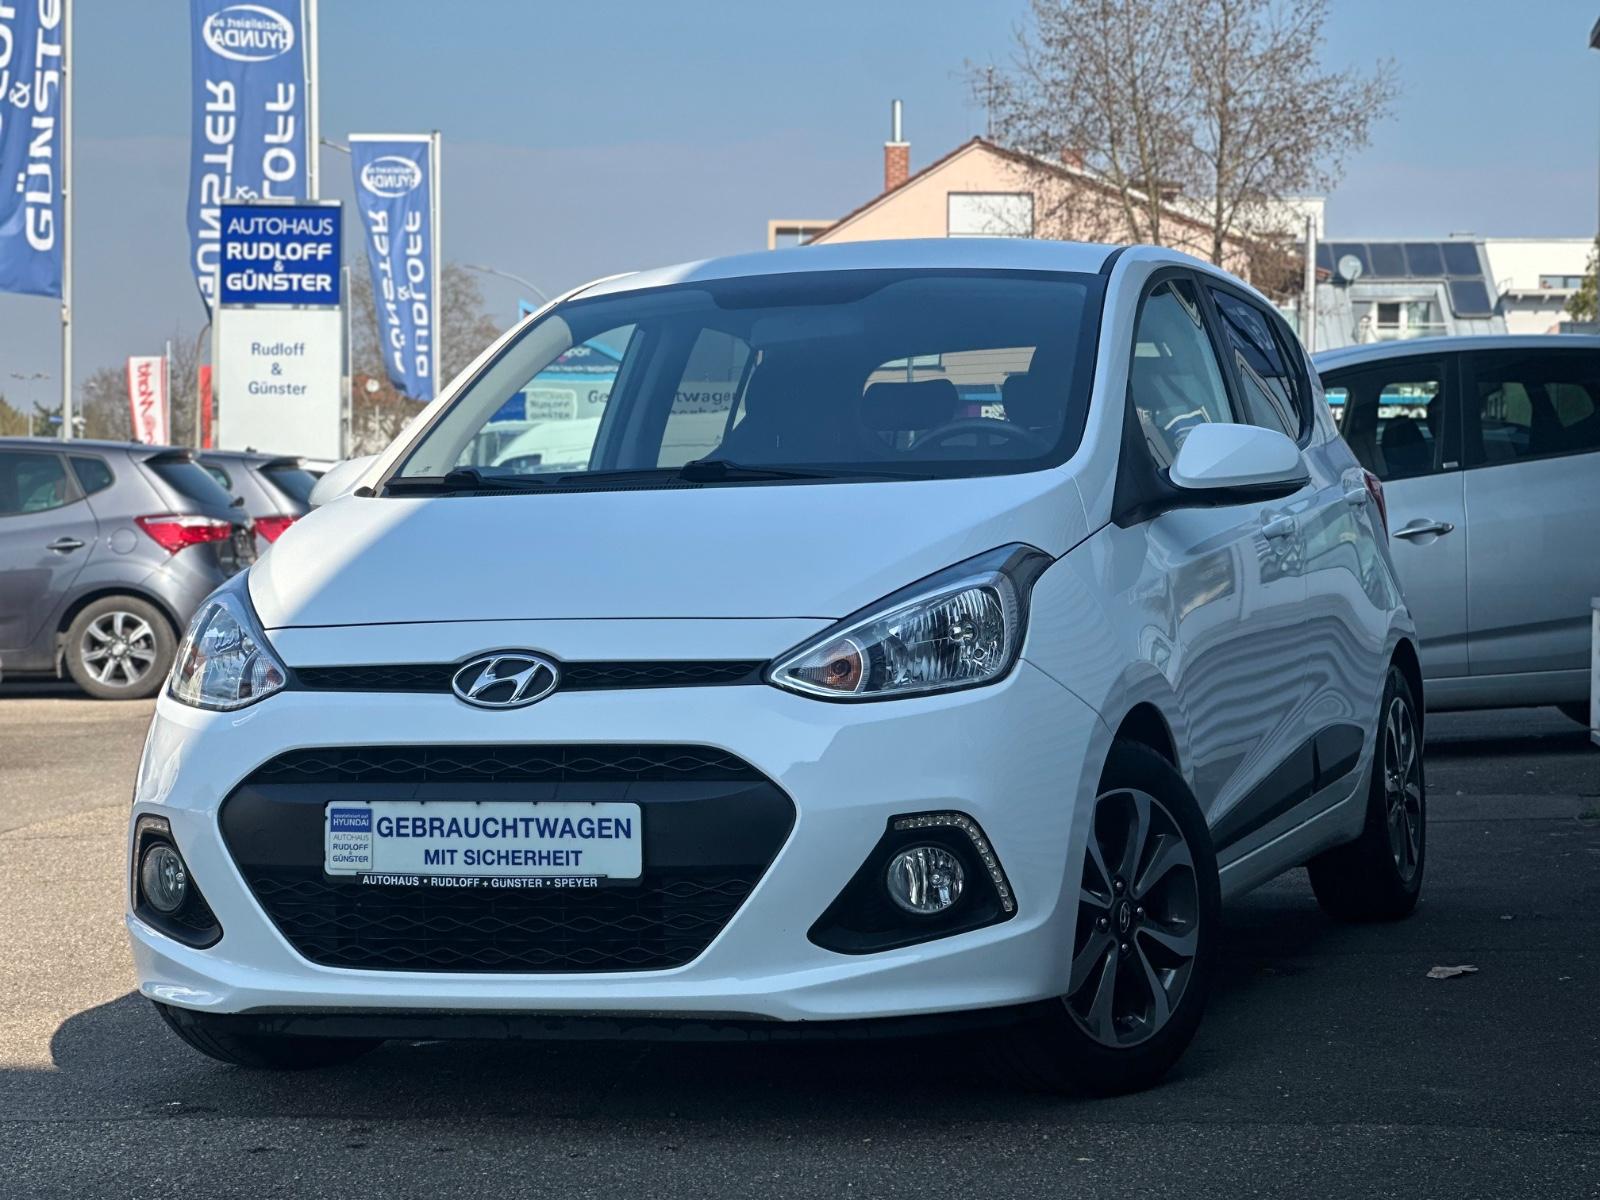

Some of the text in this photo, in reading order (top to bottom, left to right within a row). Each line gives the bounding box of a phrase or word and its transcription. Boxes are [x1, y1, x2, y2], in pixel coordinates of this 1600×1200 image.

[9, 81, 31, 109] &
[227, 217, 333, 235] AUTOHAUS
[226, 242, 332, 261] RUDLOFF
[273, 260, 284, 273] &
[226, 269, 332, 292] GÜNSTER
[251, 342, 305, 356] Rudloff
[271, 362, 283, 375] &
[248, 380, 307, 395] Günster
[333, 818, 369, 827] HYUNDAI
[376, 816, 632, 839] GEBRAUCHTWAGEN
[333, 843, 368, 851] RUDLOFF
[333, 854, 369, 862] GÜNSTER
[424, 849, 583, 867] MIT SICHERHEIT
[362, 874, 419, 886] AUTOHAUS
[431, 876, 480, 888] RUDLOFF
[554, 877, 598, 888] SPEYER
